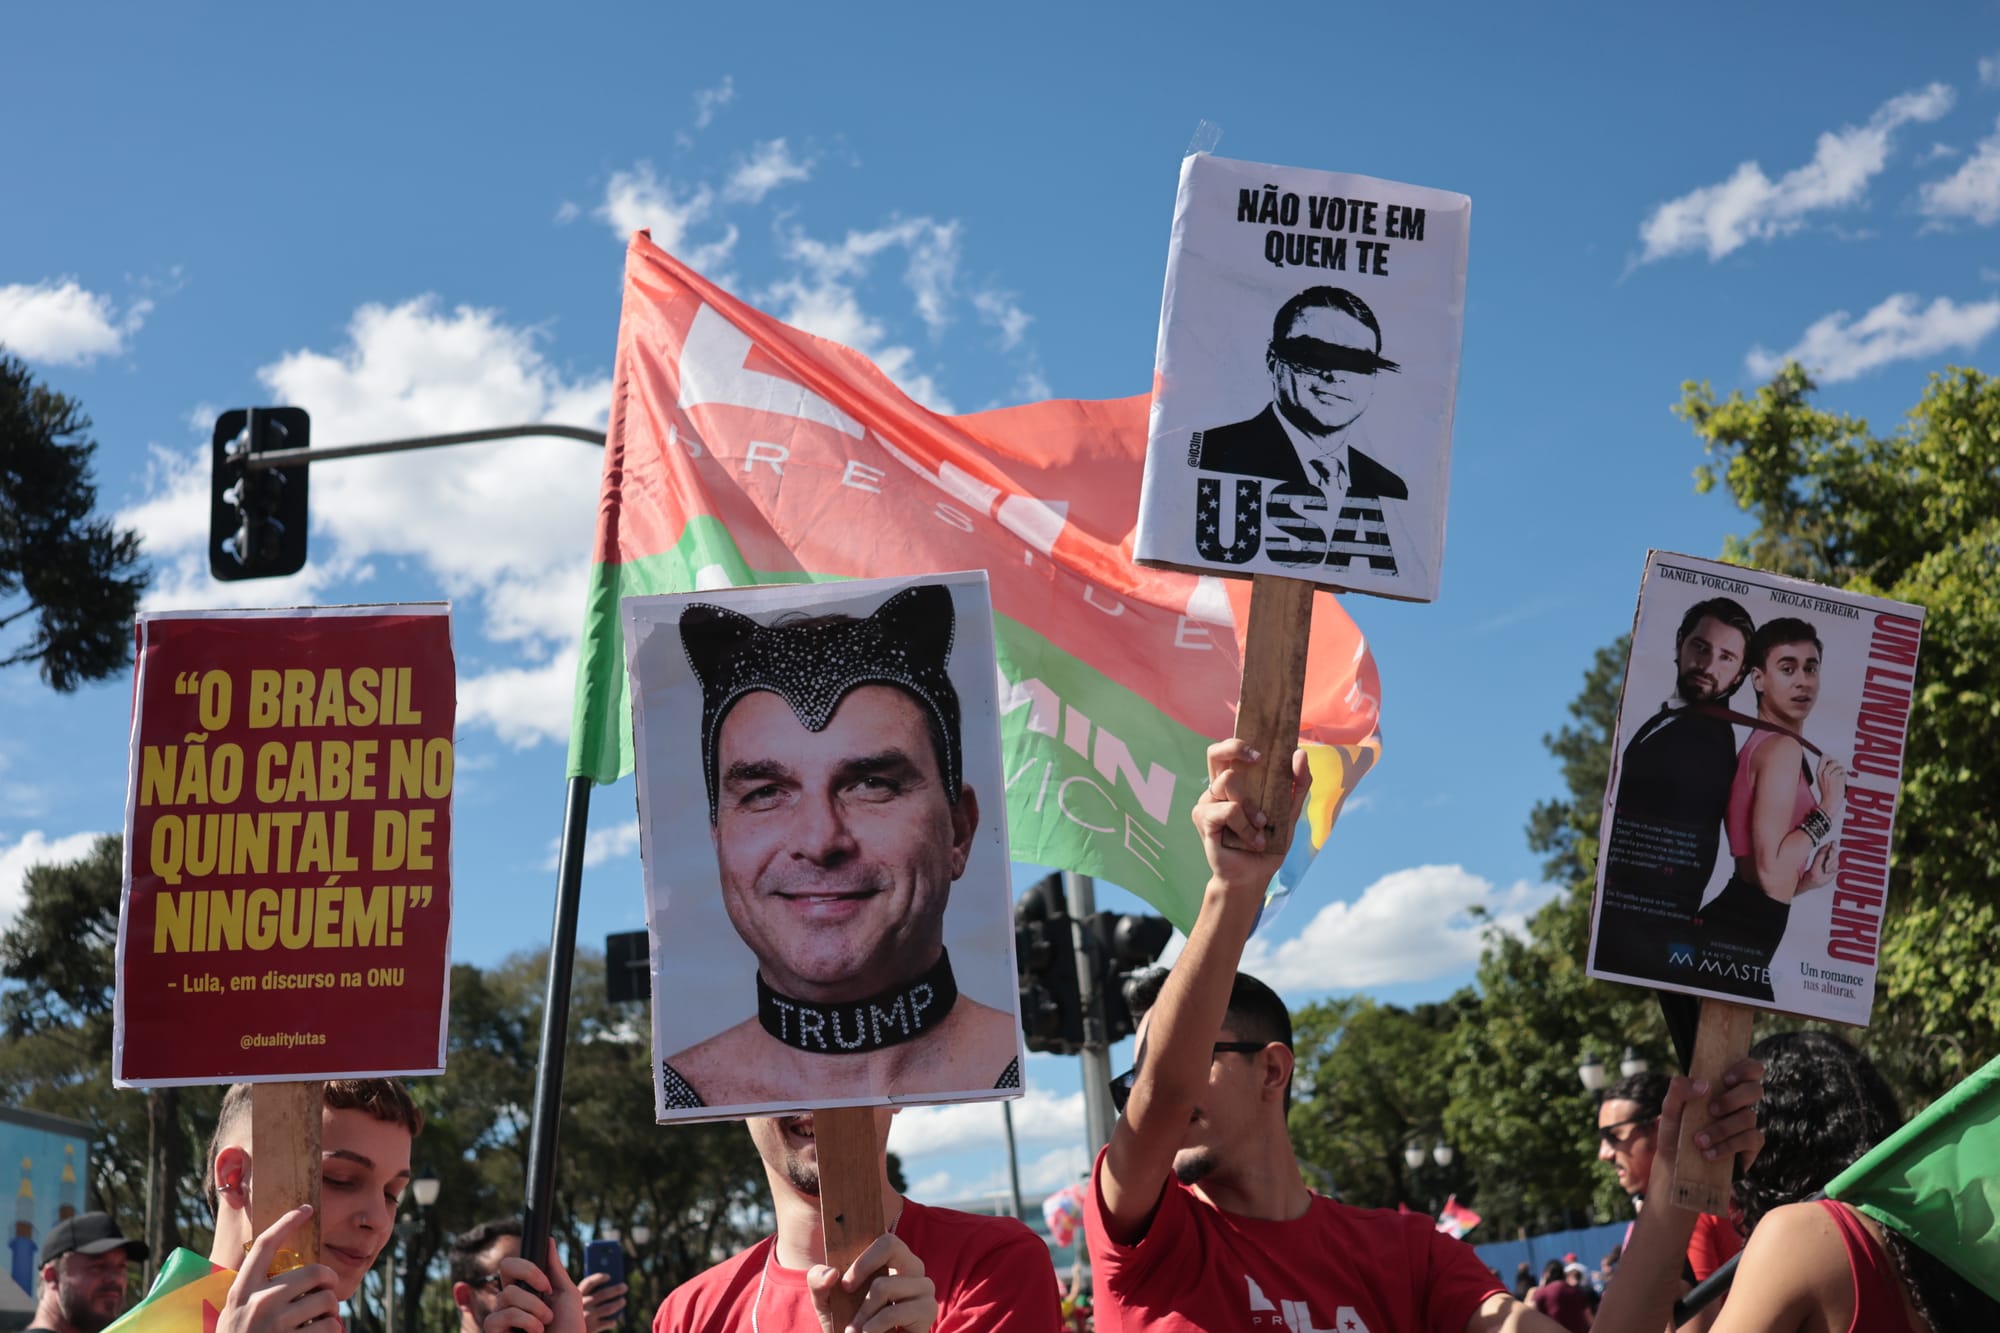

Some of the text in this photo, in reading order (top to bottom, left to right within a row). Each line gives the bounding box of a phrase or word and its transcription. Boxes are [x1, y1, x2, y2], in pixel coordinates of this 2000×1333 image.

[1237, 184, 1425, 241] NÃO VOTE EM
[1264, 231, 1390, 276] QUEM TE
[1196, 477, 1399, 578] USA
[1660, 567, 1749, 595] DANIEL VORCARO
[1769, 591, 1859, 620] NIKOLAS FERREIRA
[1868, 613, 1921, 667] UM
[249, 667, 421, 728] BRASIL
[140, 732, 452, 806] NÃO CABE NO
[150, 808, 434, 885] QUINTAL DE
[184, 974, 225, 995] Lula,
[230, 976, 256, 991] em
[262, 971, 335, 990] discurso
[340, 972, 362, 987] na
[367, 968, 404, 987] ONU
[1800, 962, 1864, 987] Um romance
[1803, 978, 1857, 1000] nas alturas.
[240, 1032, 326, 1049] @dualitylutas
[772, 983, 934, 1049] TRUMP
